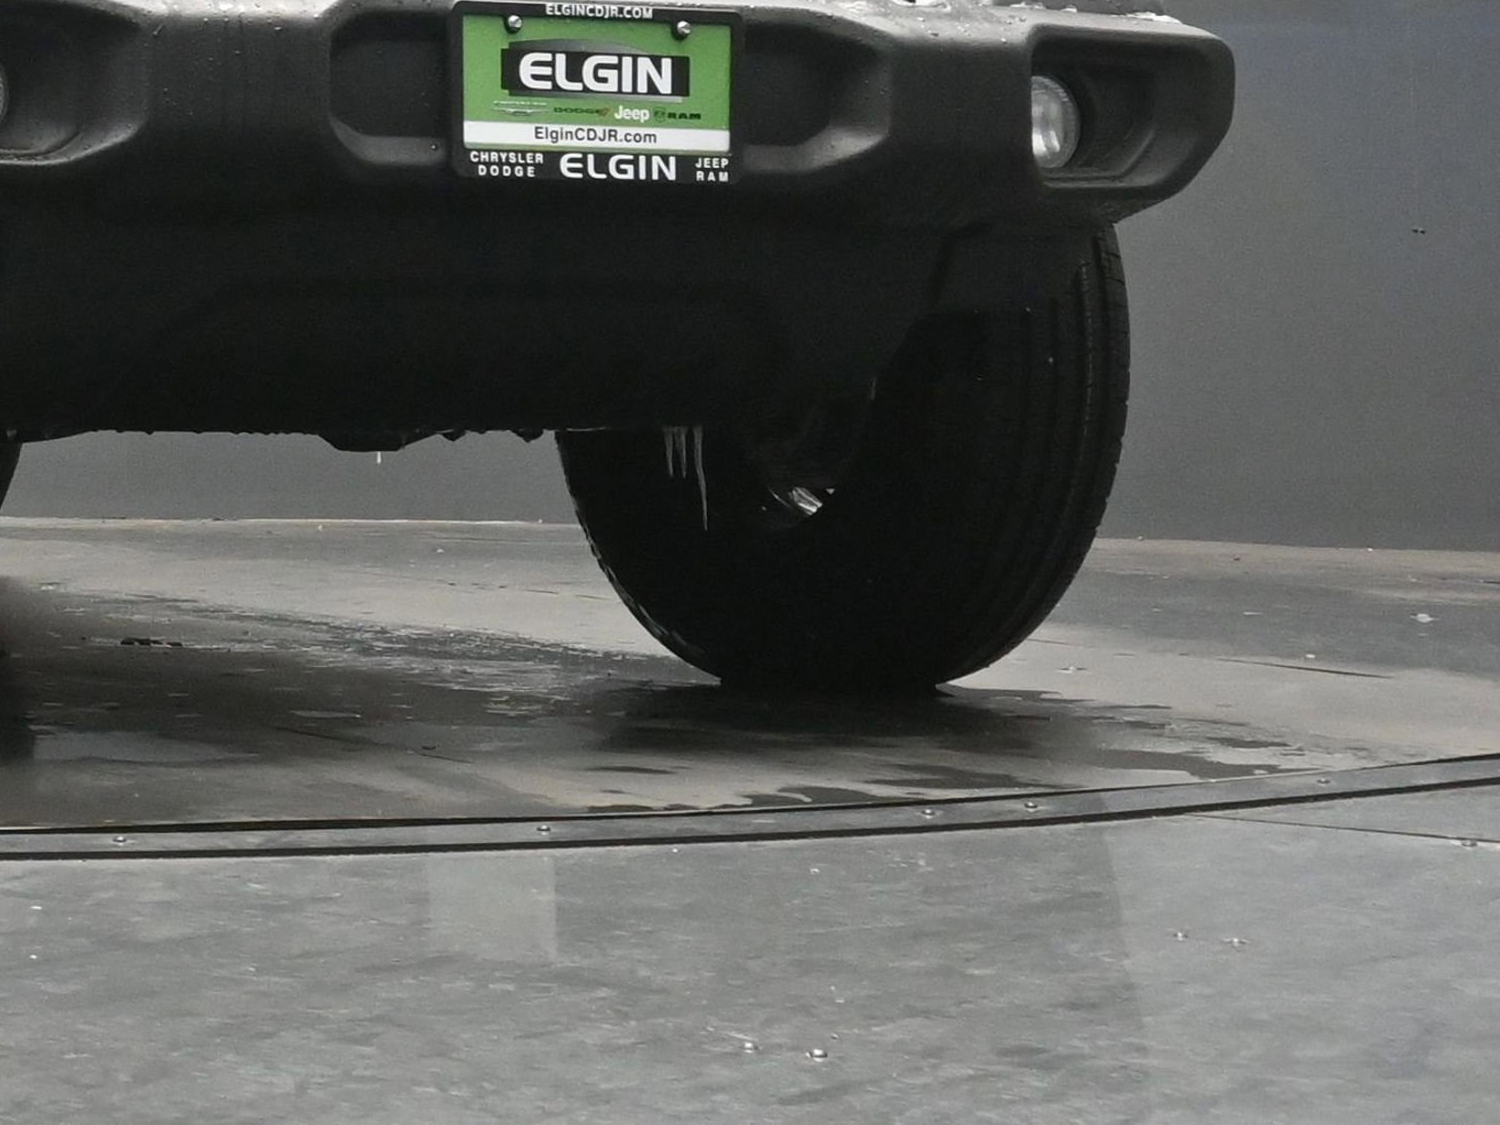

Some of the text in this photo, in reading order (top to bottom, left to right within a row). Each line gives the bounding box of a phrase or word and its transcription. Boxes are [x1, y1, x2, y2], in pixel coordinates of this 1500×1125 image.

[545, 3, 653, 19] ELGINCDJR.COM
[518, 51, 672, 94] ELGIN
[614, 105, 650, 123] Jeep
[667, 111, 702, 120] RAM
[534, 126, 657, 144] ElginCDJR.com
[470, 151, 544, 164] CHRYSLER
[695, 157, 729, 169] JEEP
[478, 164, 536, 177] DODGE
[560, 153, 676, 181] ELGIN
[696, 170, 729, 182] RAM
